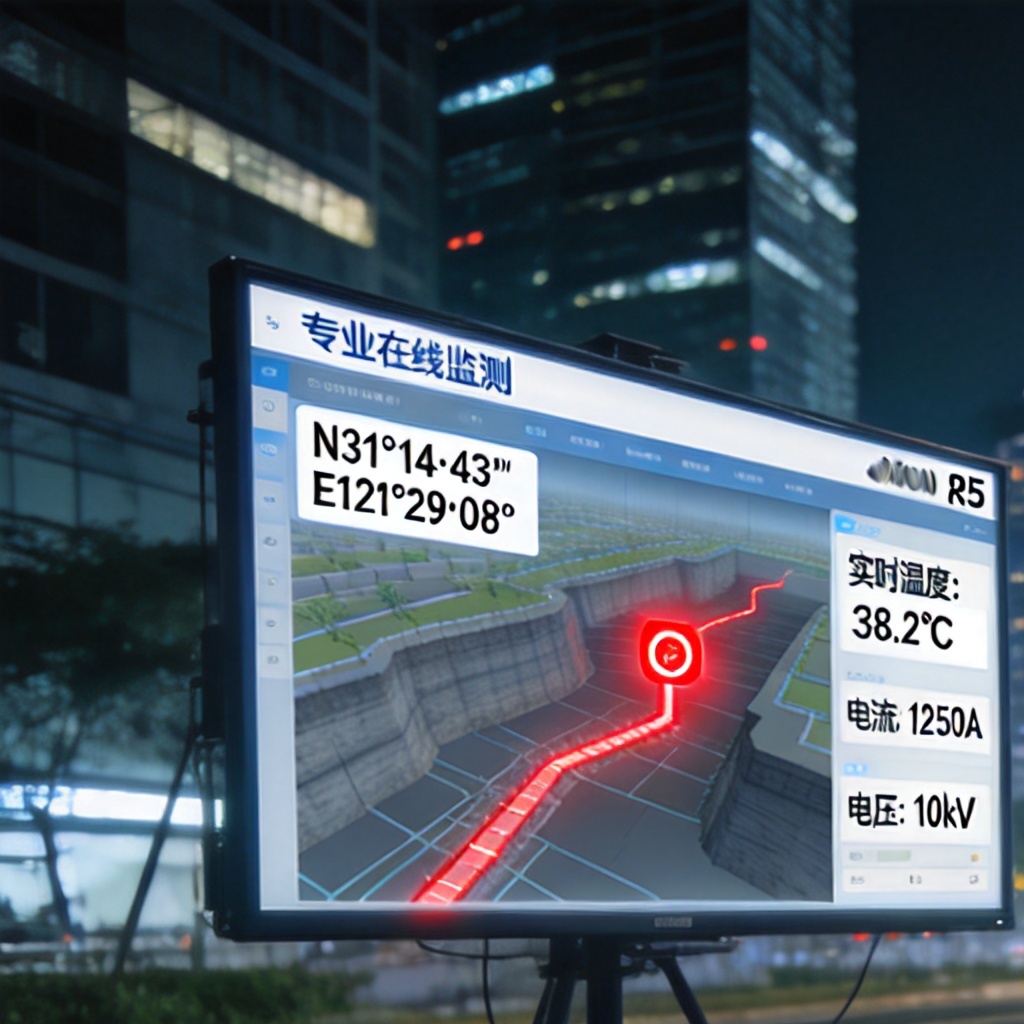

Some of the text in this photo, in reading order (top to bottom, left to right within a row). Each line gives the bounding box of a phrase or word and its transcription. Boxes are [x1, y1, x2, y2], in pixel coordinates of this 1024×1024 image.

[301, 311, 512, 396] 专业在线监测
[947, 473, 985, 509] R5
[908, 702, 983, 739] 1250A
[914, 791, 976, 829] 10kV
